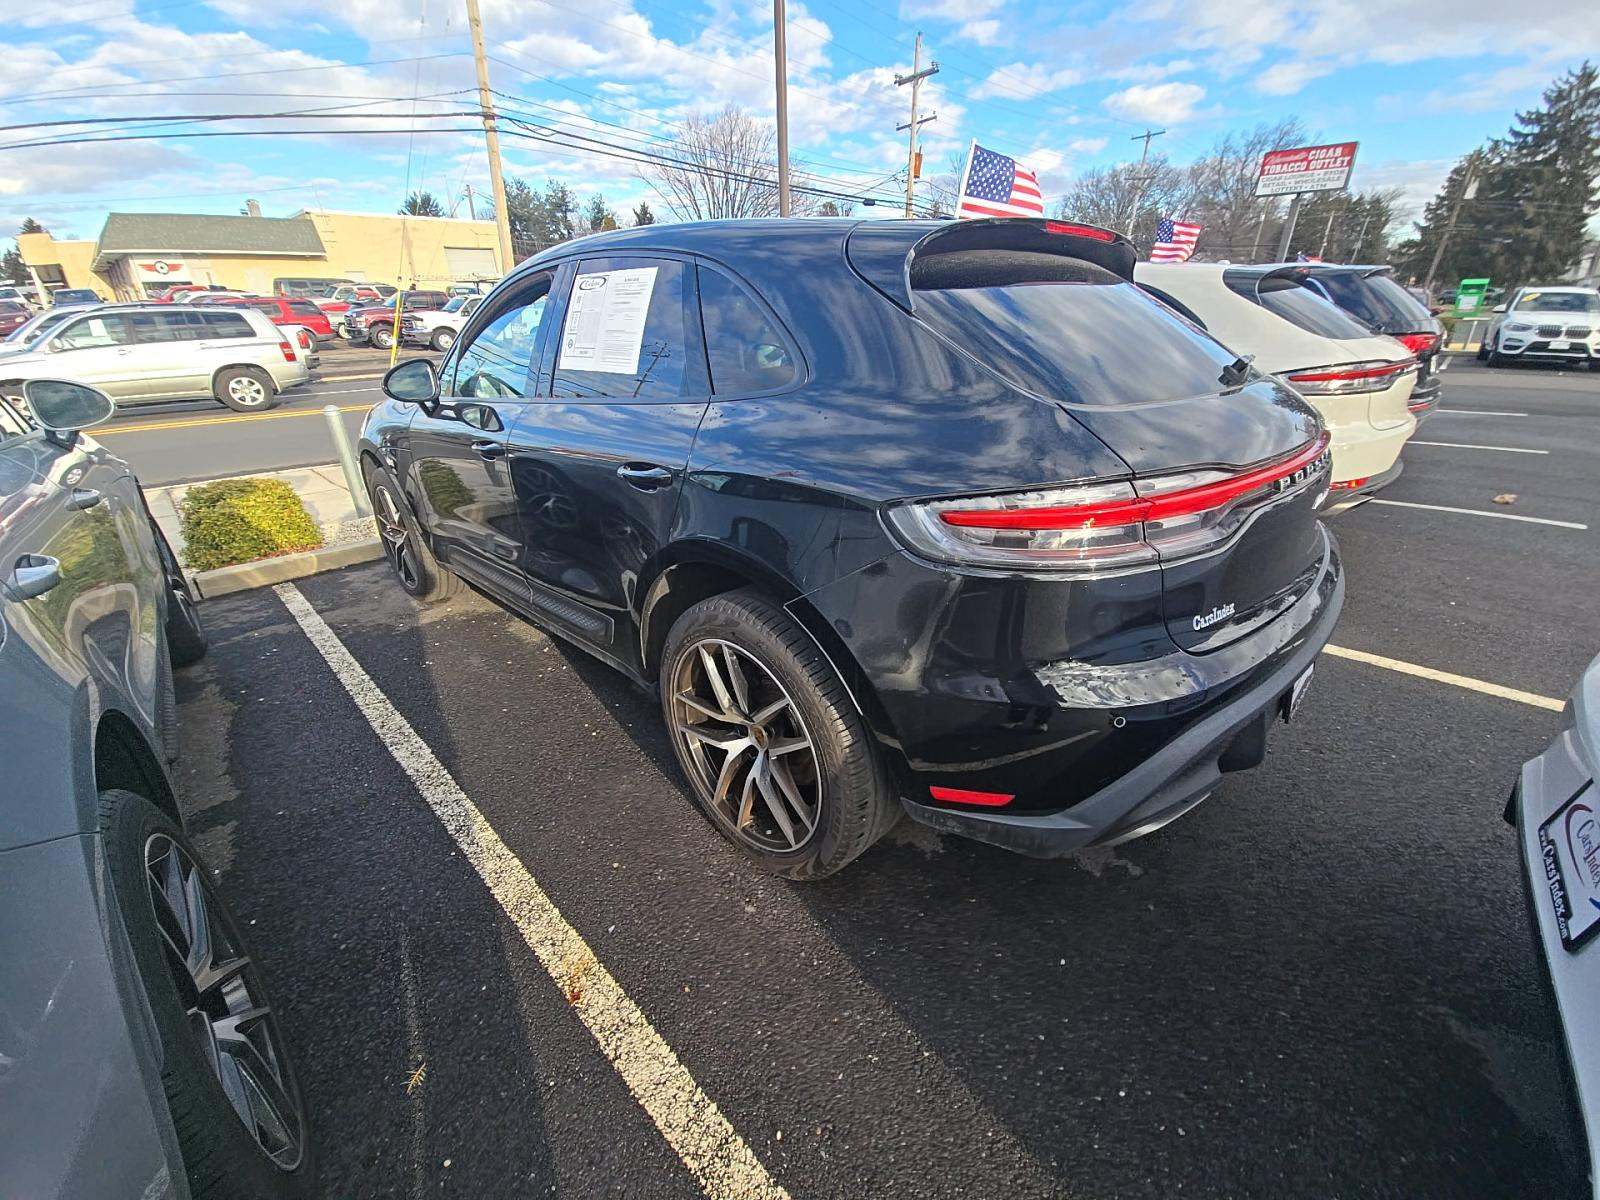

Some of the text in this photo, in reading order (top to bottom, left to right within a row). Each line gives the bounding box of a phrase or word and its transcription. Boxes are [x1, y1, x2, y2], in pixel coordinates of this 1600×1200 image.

[1308, 147, 1343, 160] CIGAR
[1263, 160, 1307, 175] TOBACCO
[1309, 156, 1351, 170] OUTLET
[1271, 185, 1303, 193] LOTTERY
[1192, 602, 1236, 631] CarsIndex
